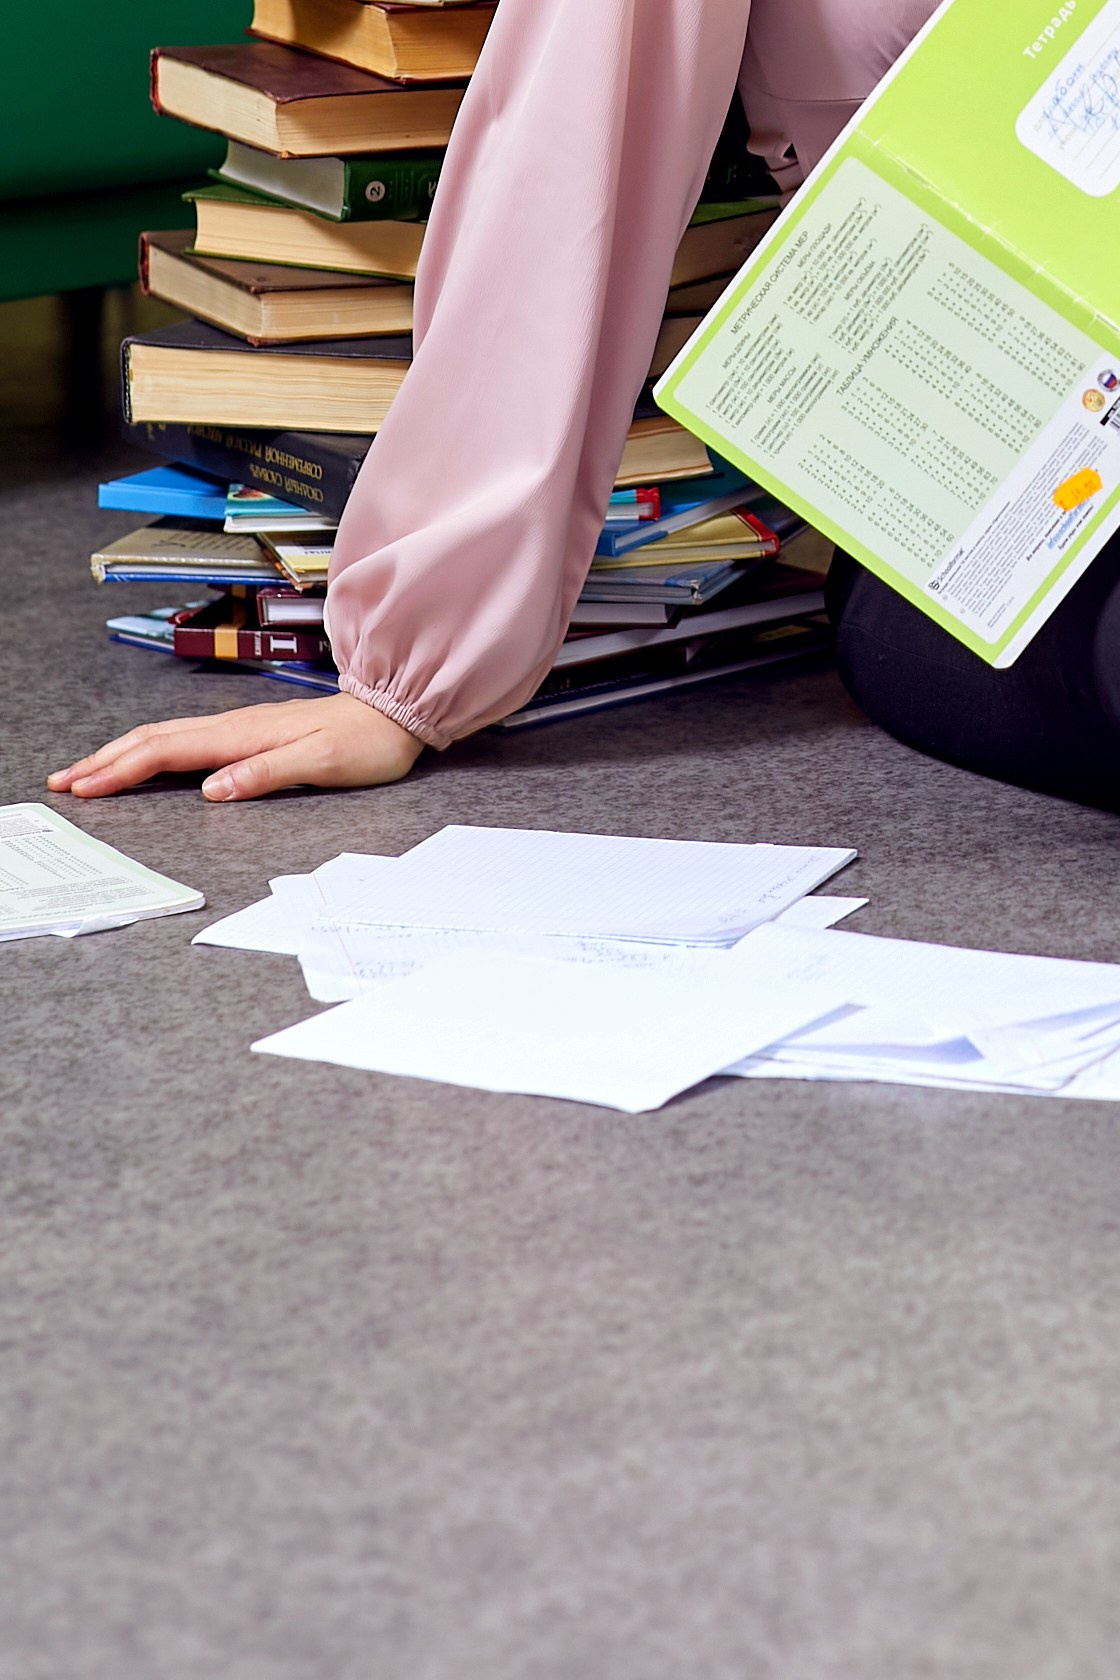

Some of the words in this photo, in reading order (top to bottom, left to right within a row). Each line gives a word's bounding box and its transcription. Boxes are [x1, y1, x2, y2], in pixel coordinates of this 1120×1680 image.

[1022, 0, 1076, 58] Тетрадь
[369, 185, 381, 197] 2
[730, 281, 772, 335] МЕТРИЧЕСКАЯ
[769, 248, 798, 282] СИСТЕМА
[794, 230, 808, 248] МЕР
[835, 363, 864, 396] ТАБЛИЦА
[860, 316, 898, 364] УМНОЖЕНИЯ
[249, 464, 283, 487] СЛОВАРЬ
[265, 444, 323, 481] СОВРЕМЕННОЙ
[285, 476, 324, 503] СВОДНЫЙ
